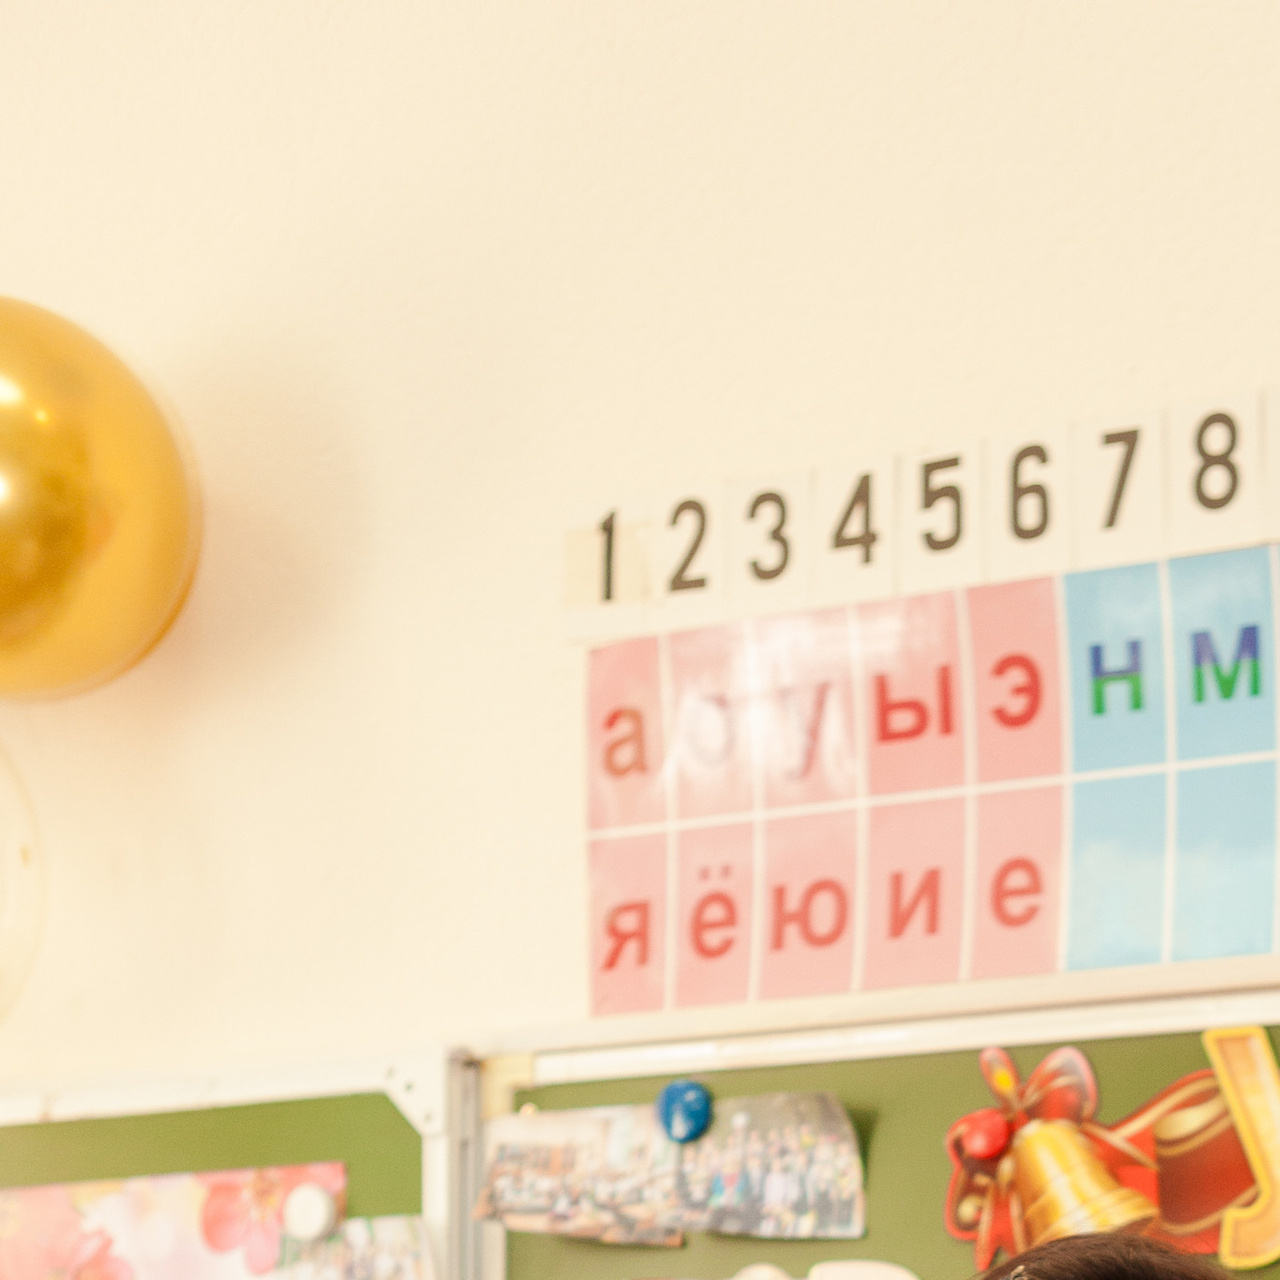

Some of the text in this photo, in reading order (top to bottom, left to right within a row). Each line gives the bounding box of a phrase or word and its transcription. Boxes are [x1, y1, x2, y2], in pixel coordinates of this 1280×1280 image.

[598, 511, 617, 603] 1
[668, 498, 708, 593] 2
[747, 490, 791, 582] 3
[831, 473, 879, 565] 4
[920, 455, 964, 553] 5
[1009, 443, 1051, 542] 6
[1101, 428, 1141, 529] 7
[1192, 411, 1241, 512] 8
[874, 664, 956, 745] ы
[989, 652, 1045, 731] э
[1087, 638, 1147, 717] н
[1190, 623, 1264, 706] м
[602, 900, 651, 972] я
[690, 864, 738, 960] ё
[771, 878, 849, 951] ю
[889, 868, 941, 939] и
[990, 857, 1042, 928] е
